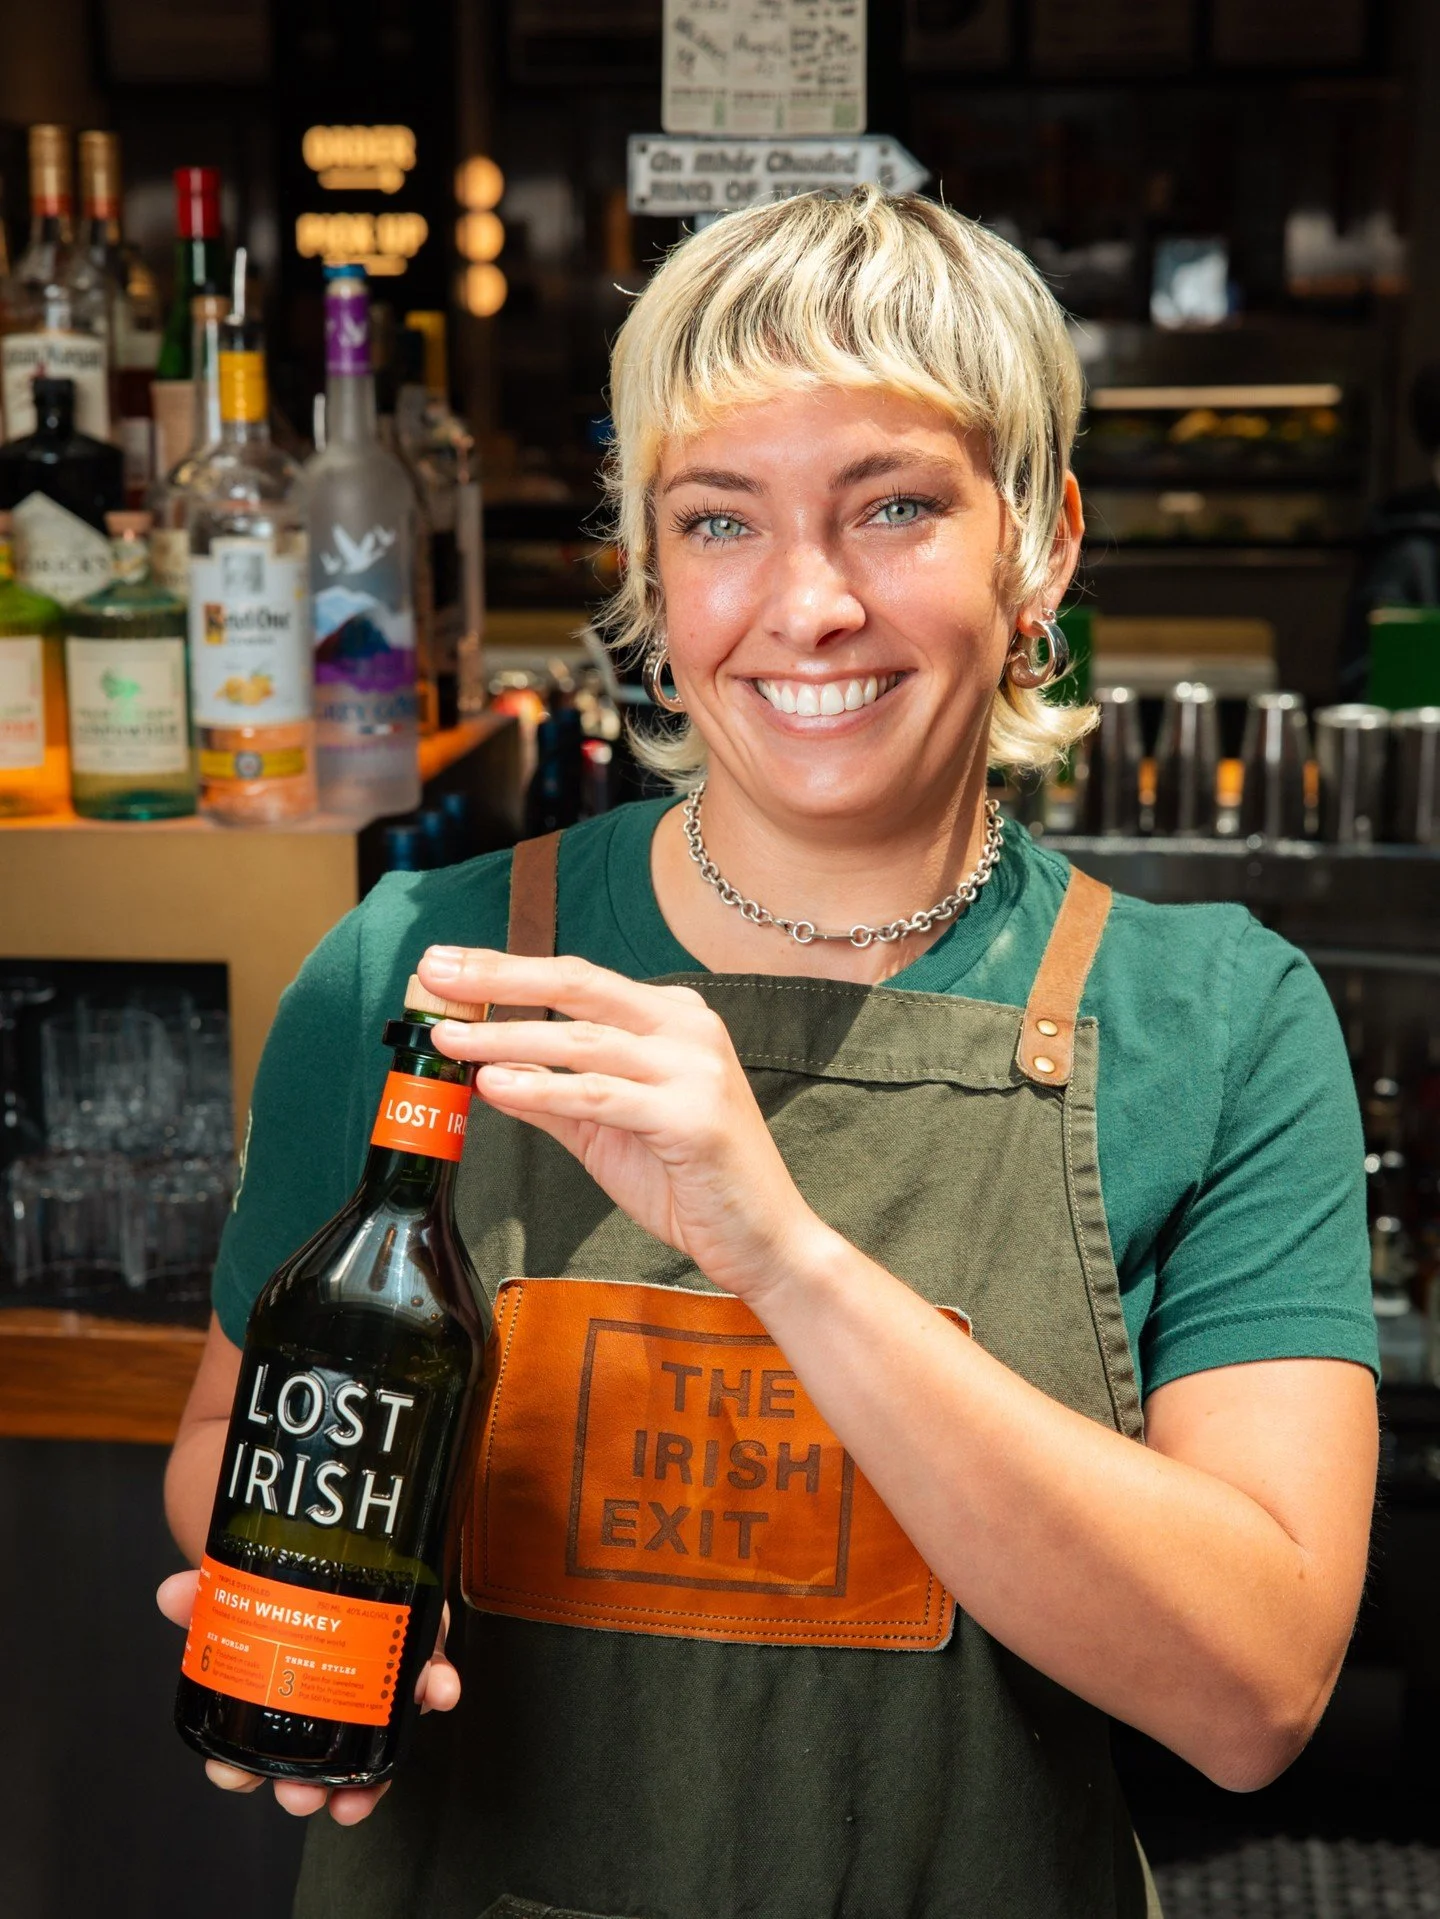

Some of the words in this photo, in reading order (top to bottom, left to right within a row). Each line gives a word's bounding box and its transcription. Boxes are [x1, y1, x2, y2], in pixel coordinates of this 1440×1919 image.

[386, 1099, 441, 1130] LOST
[247, 1364, 415, 1453] LOST
[661, 1360, 798, 1419] THE
[632, 1429, 822, 1494] IRISH
[227, 1442, 404, 1535] IRISH
[600, 1498, 770, 1560] EXIT
[214, 1587, 251, 1613] IRISH
[255, 1600, 342, 1633] WHISKEY
[200, 1644, 213, 1673] 6
[220, 1637, 250, 1653] WORLDS
[284, 1655, 316, 1669] THREE
[321, 1663, 357, 1676] STYLES
[277, 1668, 296, 1698] 3
